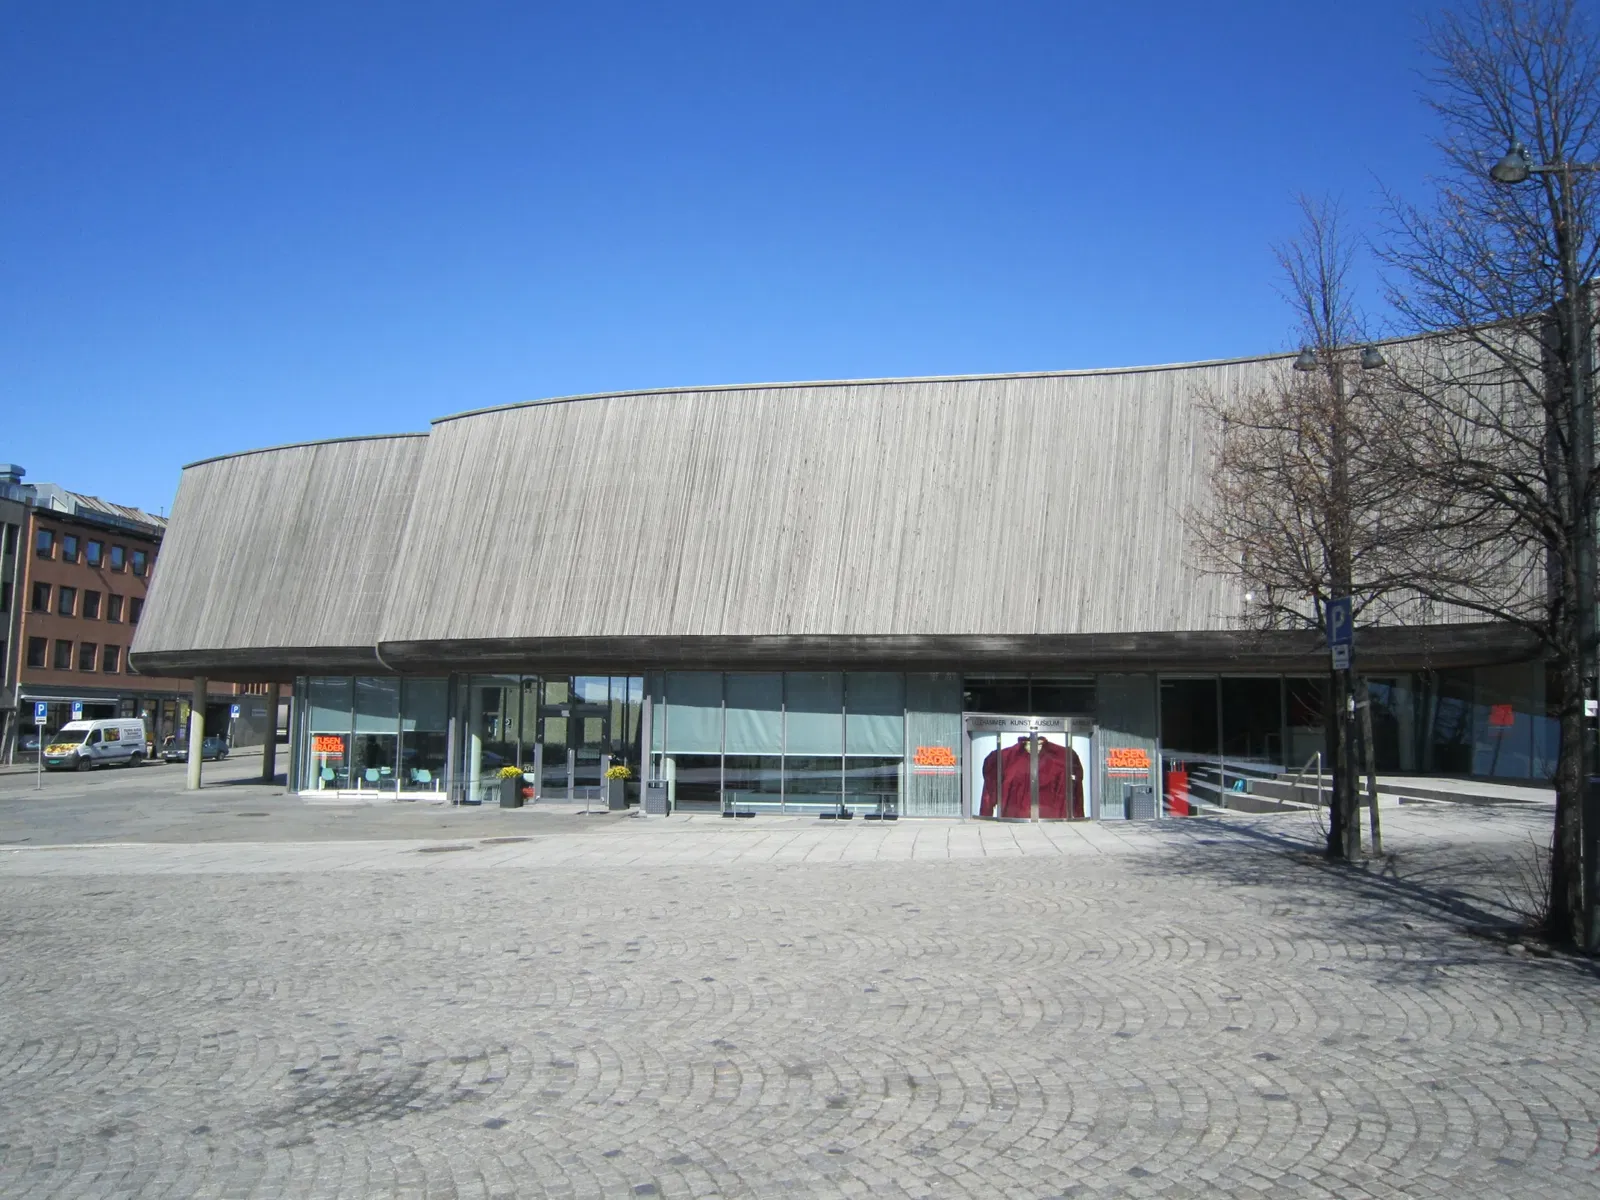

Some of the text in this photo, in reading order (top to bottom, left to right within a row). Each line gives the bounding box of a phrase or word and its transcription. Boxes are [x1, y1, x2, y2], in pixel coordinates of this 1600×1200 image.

[1332, 605, 1345, 642] P
[38, 704, 45, 716] P
[315, 736, 342, 745] TUSEN
[916, 746, 952, 756] TUSEN
[1109, 748, 1146, 758] TUSEN
